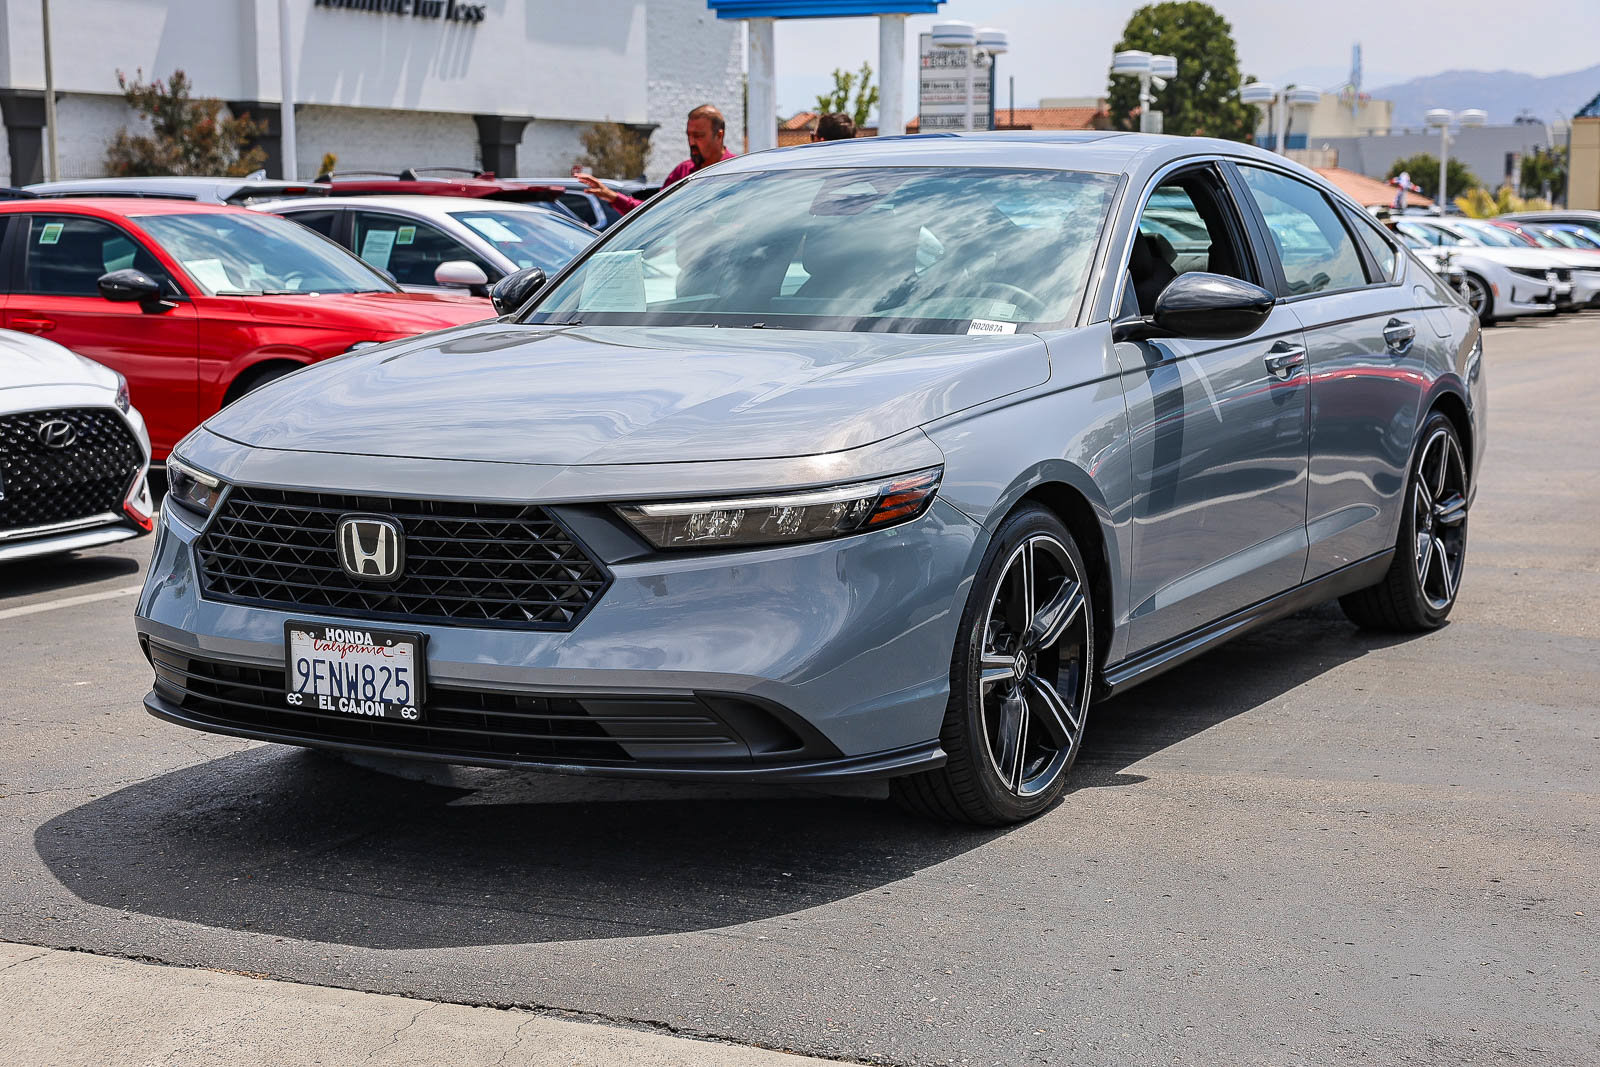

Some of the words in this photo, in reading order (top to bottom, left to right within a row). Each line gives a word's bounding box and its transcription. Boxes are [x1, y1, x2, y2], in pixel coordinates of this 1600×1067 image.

[325, 628, 374, 646] HONDA
[313, 639, 394, 659] California
[297, 657, 410, 705] 9FNW825
[319, 695, 336, 711] EL
[338, 698, 385, 717] CAJON
